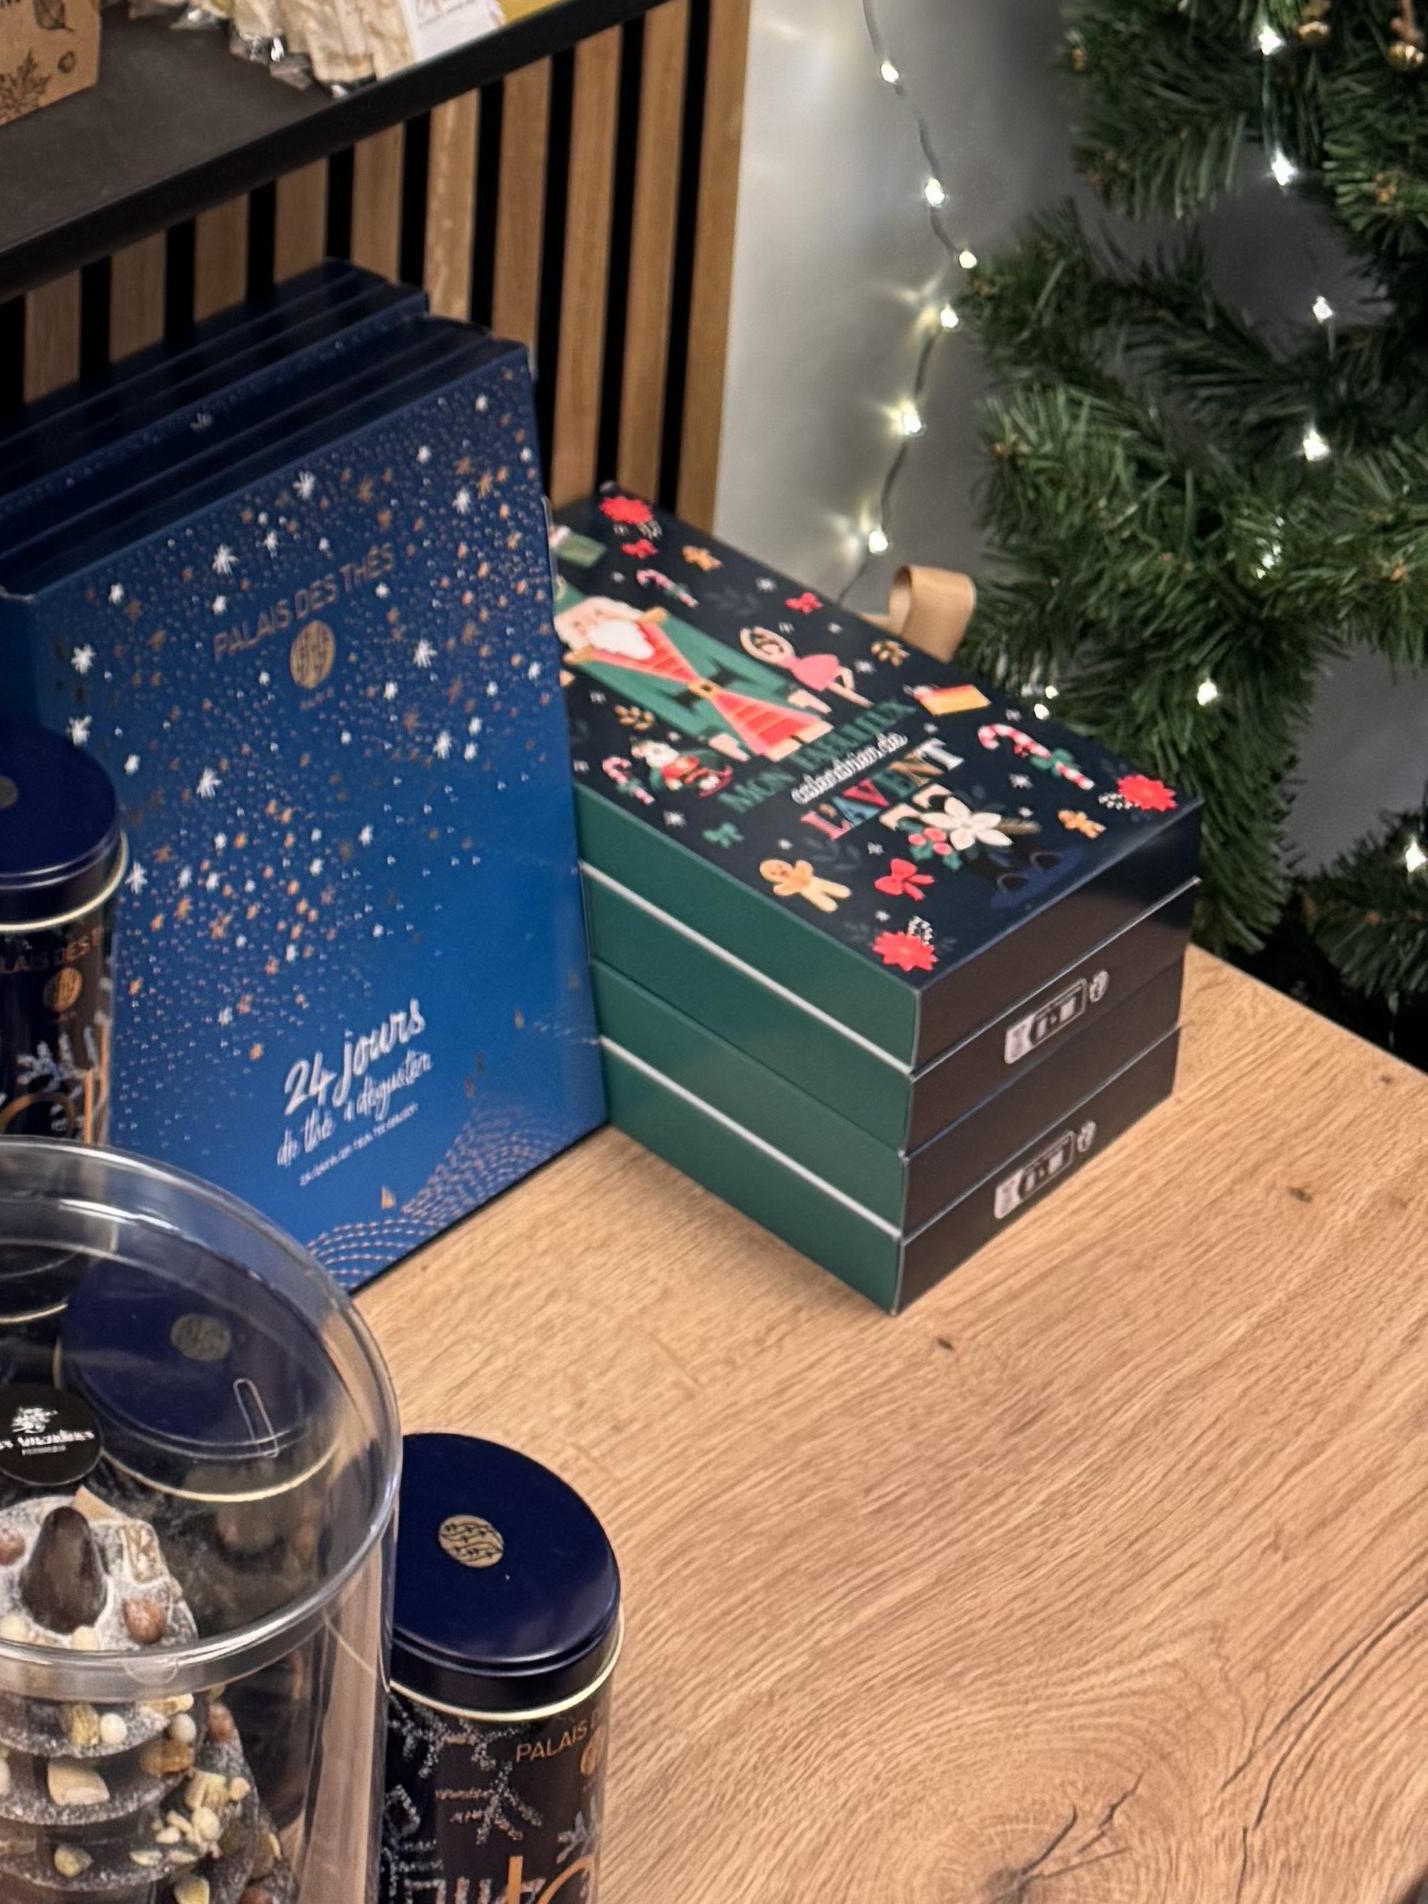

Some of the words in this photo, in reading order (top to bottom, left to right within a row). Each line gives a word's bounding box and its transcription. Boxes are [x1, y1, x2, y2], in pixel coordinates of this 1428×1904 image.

[213, 598, 293, 664] PALAIS
[294, 573, 338, 620] DES
[284, 1050, 338, 1116] 24
[331, 997, 426, 1108] jours
[515, 1719, 588, 1763] PALAIS
